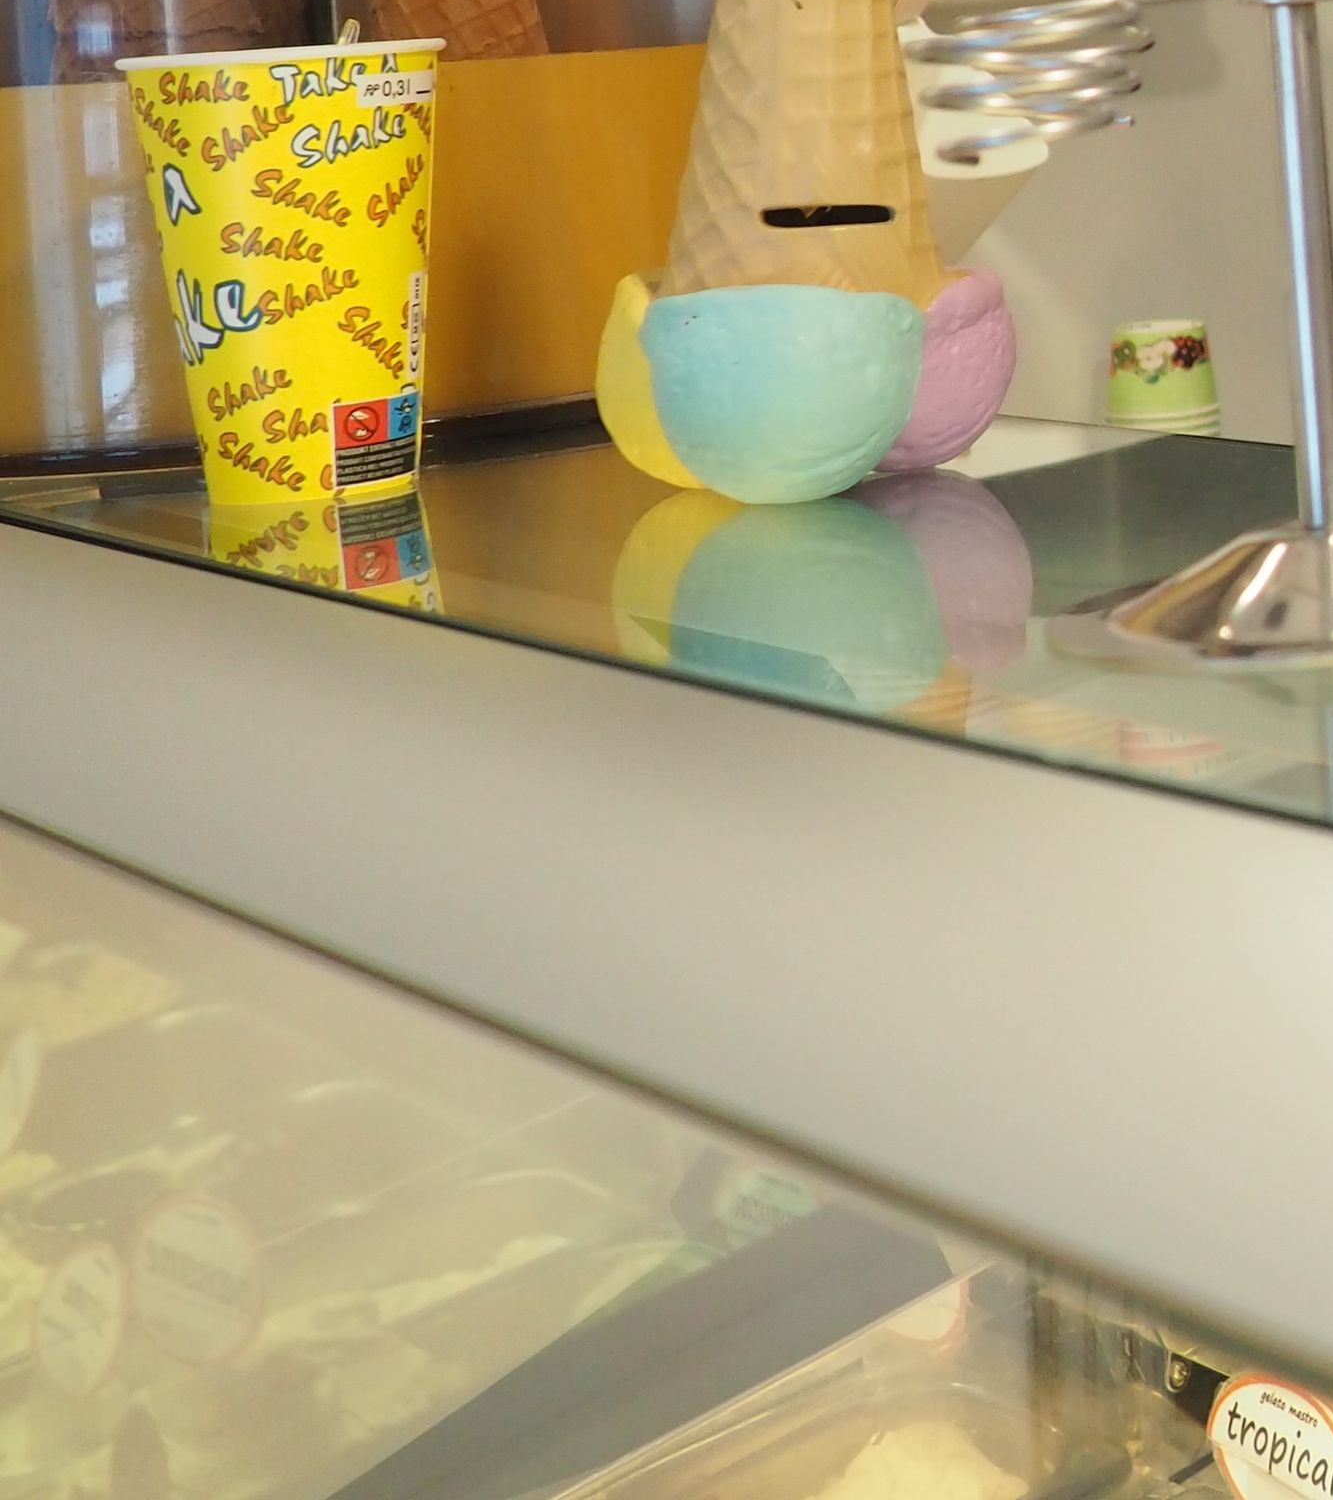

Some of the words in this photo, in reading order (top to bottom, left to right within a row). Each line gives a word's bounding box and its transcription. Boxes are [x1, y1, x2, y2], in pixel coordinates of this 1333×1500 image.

[158, 68, 250, 107] Shake
[268, 56, 367, 108] Take
[134, 87, 191, 158] Shake
[200, 104, 295, 172] Shake
[291, 105, 408, 169] Shake
[250, 168, 351, 228] Shake
[366, 153, 425, 229] Shake
[220, 221, 324, 263] Shake
[257, 266, 360, 325] Shake
[336, 304, 404, 380] Shake
[207, 365, 293, 422] Shake
[262, 407, 329, 444] Sha
[217, 431, 307, 493] Shake
[1259, 1390, 1286, 1411] gelato
[1288, 1405, 1319, 1428] mastro
